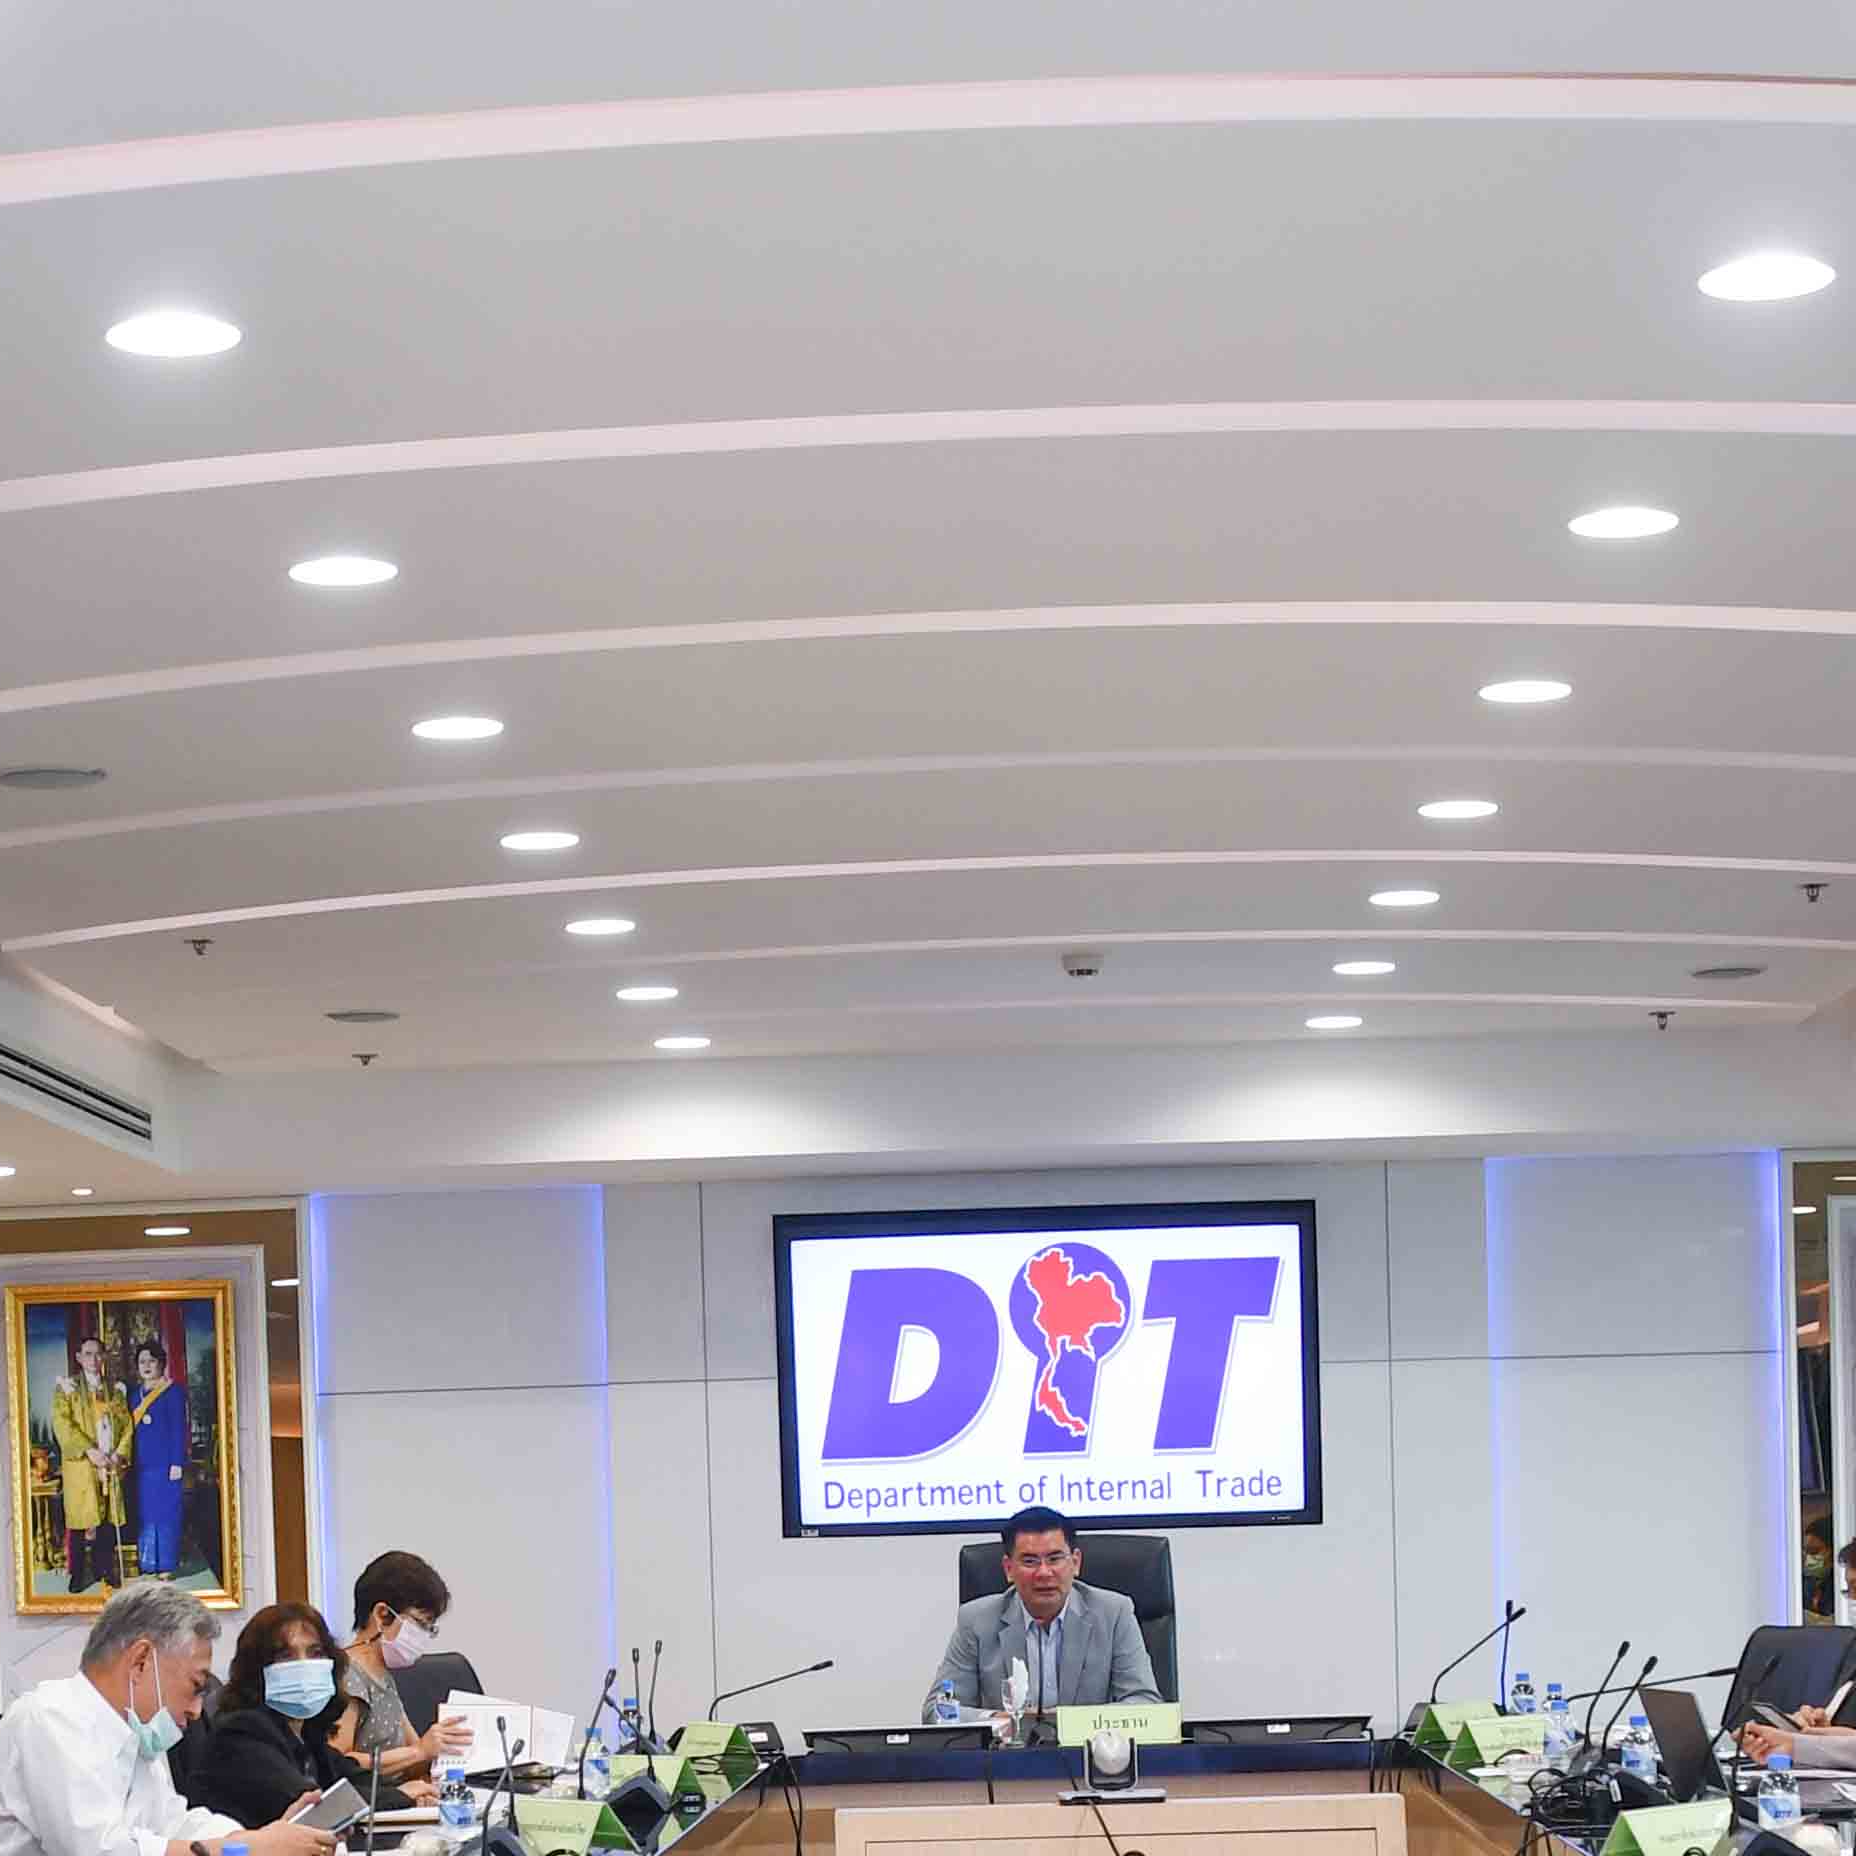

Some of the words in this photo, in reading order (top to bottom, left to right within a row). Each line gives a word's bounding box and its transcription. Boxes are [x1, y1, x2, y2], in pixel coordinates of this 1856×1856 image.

[823, 1480, 1006, 1518] Department
[1018, 1475, 1048, 1504] of
[1059, 1471, 1172, 1504] Internal
[1195, 1468, 1283, 1499] Trade
[1092, 1713, 1149, 1730] ประธาน
